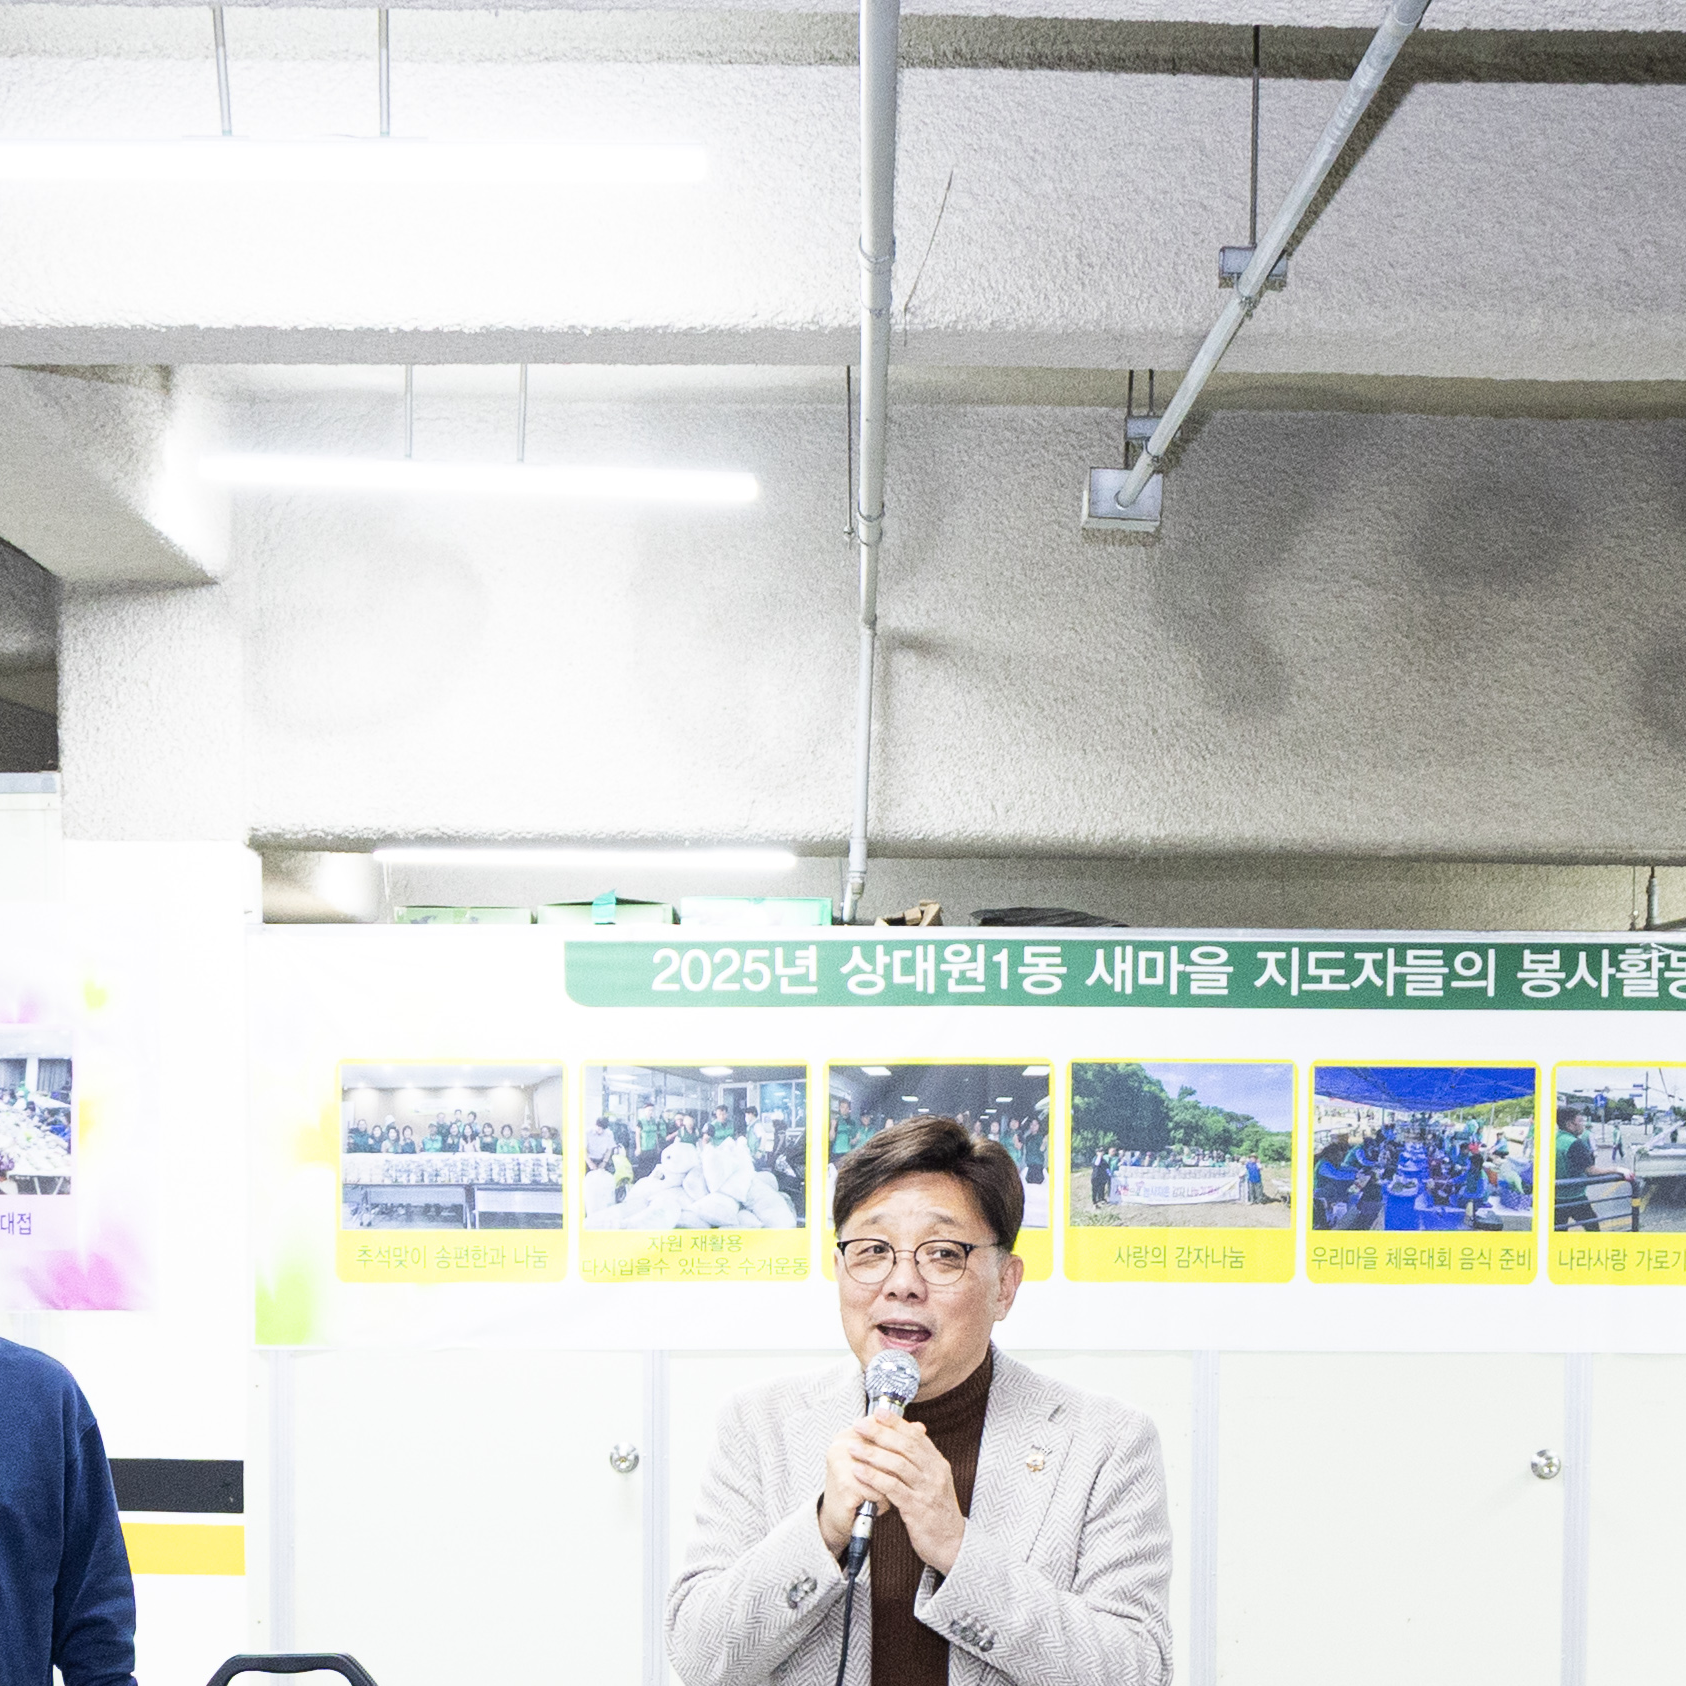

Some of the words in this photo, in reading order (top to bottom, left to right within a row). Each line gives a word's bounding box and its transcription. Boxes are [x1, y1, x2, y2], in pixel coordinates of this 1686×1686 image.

[651, 945, 819, 993] 2025년
[839, 944, 1068, 995] 상대원1동
[1086, 944, 1232, 996] 새마을
[1253, 948, 1496, 998] 지도자들의
[0, 1211, 32, 1236] 대접
[648, 1234, 683, 1253] 자원
[690, 1234, 744, 1253] 재활용
[356, 1245, 428, 1269] 추석맞이
[434, 1245, 507, 1269] 송편한과
[514, 1245, 549, 1269] 나눔
[737, 1257, 809, 1276] 수거운동
[1114, 1245, 1167, 1269] 사랑의
[1175, 1245, 1246, 1270] 감자나눔
[1311, 1246, 1379, 1270] 우리마을
[1385, 1246, 1452, 1271] 체육대회
[1458, 1247, 1492, 1271] 음식
[1498, 1247, 1532, 1271] 준비
[1558, 1247, 1628, 1272] 나라사랑
